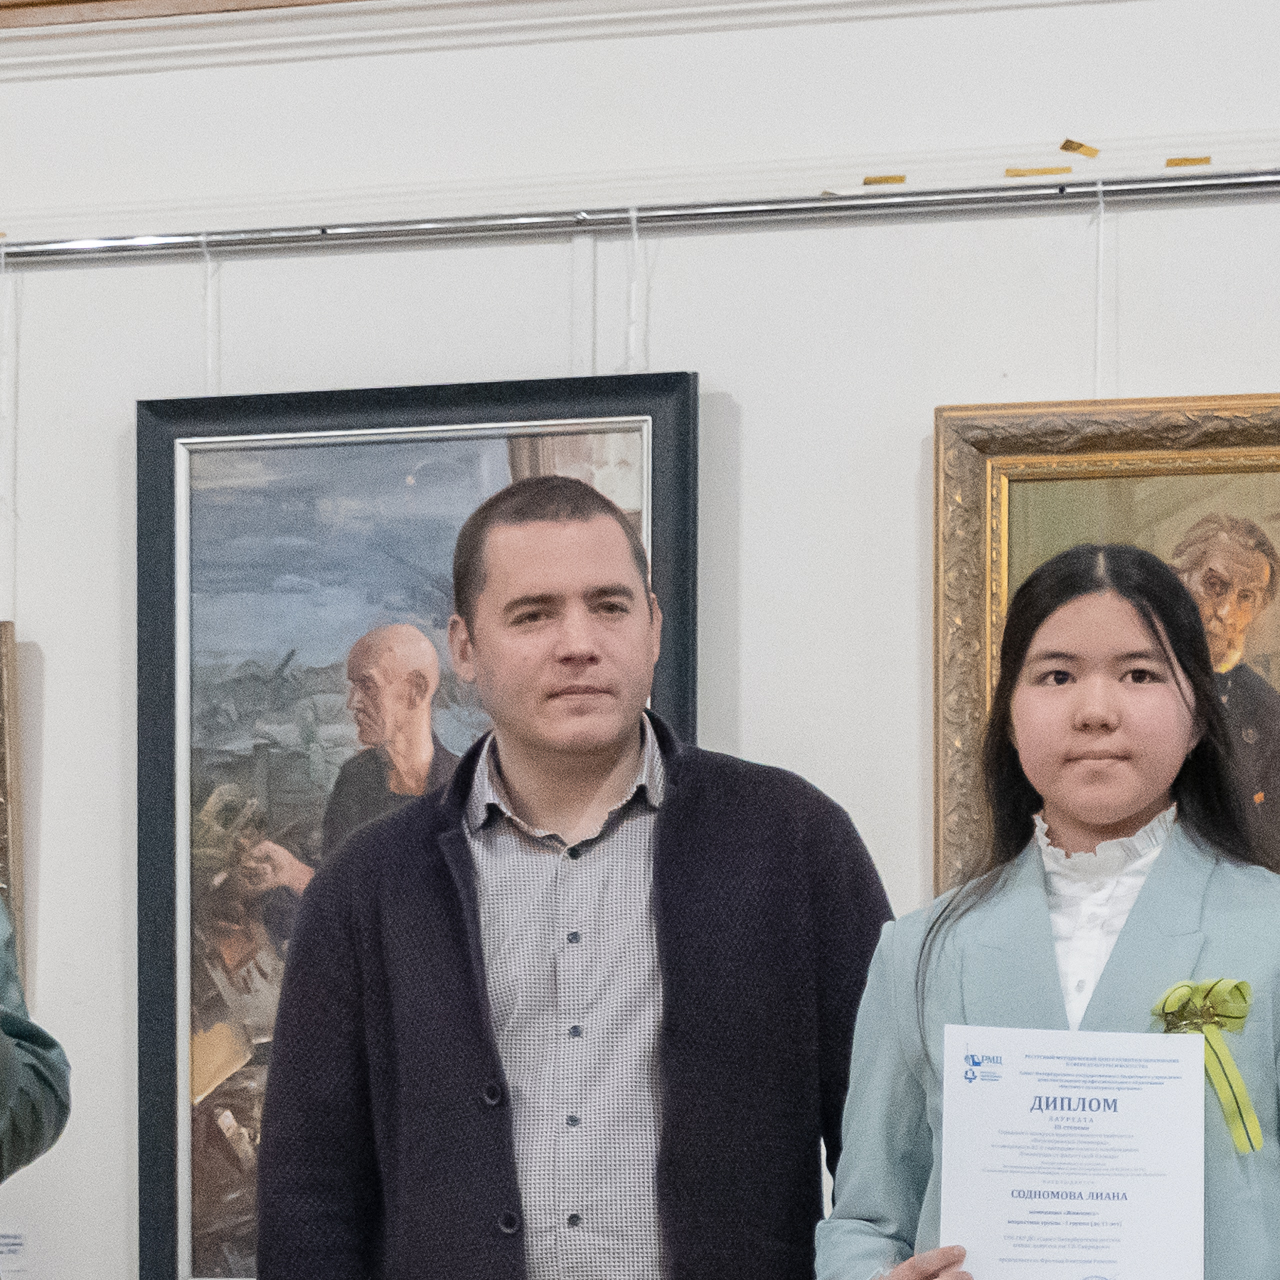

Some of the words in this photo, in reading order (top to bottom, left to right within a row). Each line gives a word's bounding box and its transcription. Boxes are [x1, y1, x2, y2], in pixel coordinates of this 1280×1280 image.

[981, 1055, 1003, 1066] РМЦ
[1030, 1095, 1119, 1113] ДИПЛОМ
[1048, 1115, 1094, 1123] ЛАУРЕАТА
[1010, 1189, 1084, 1201] СОДНОМОВА
[1086, 1191, 1128, 1201] ЛИАНА
